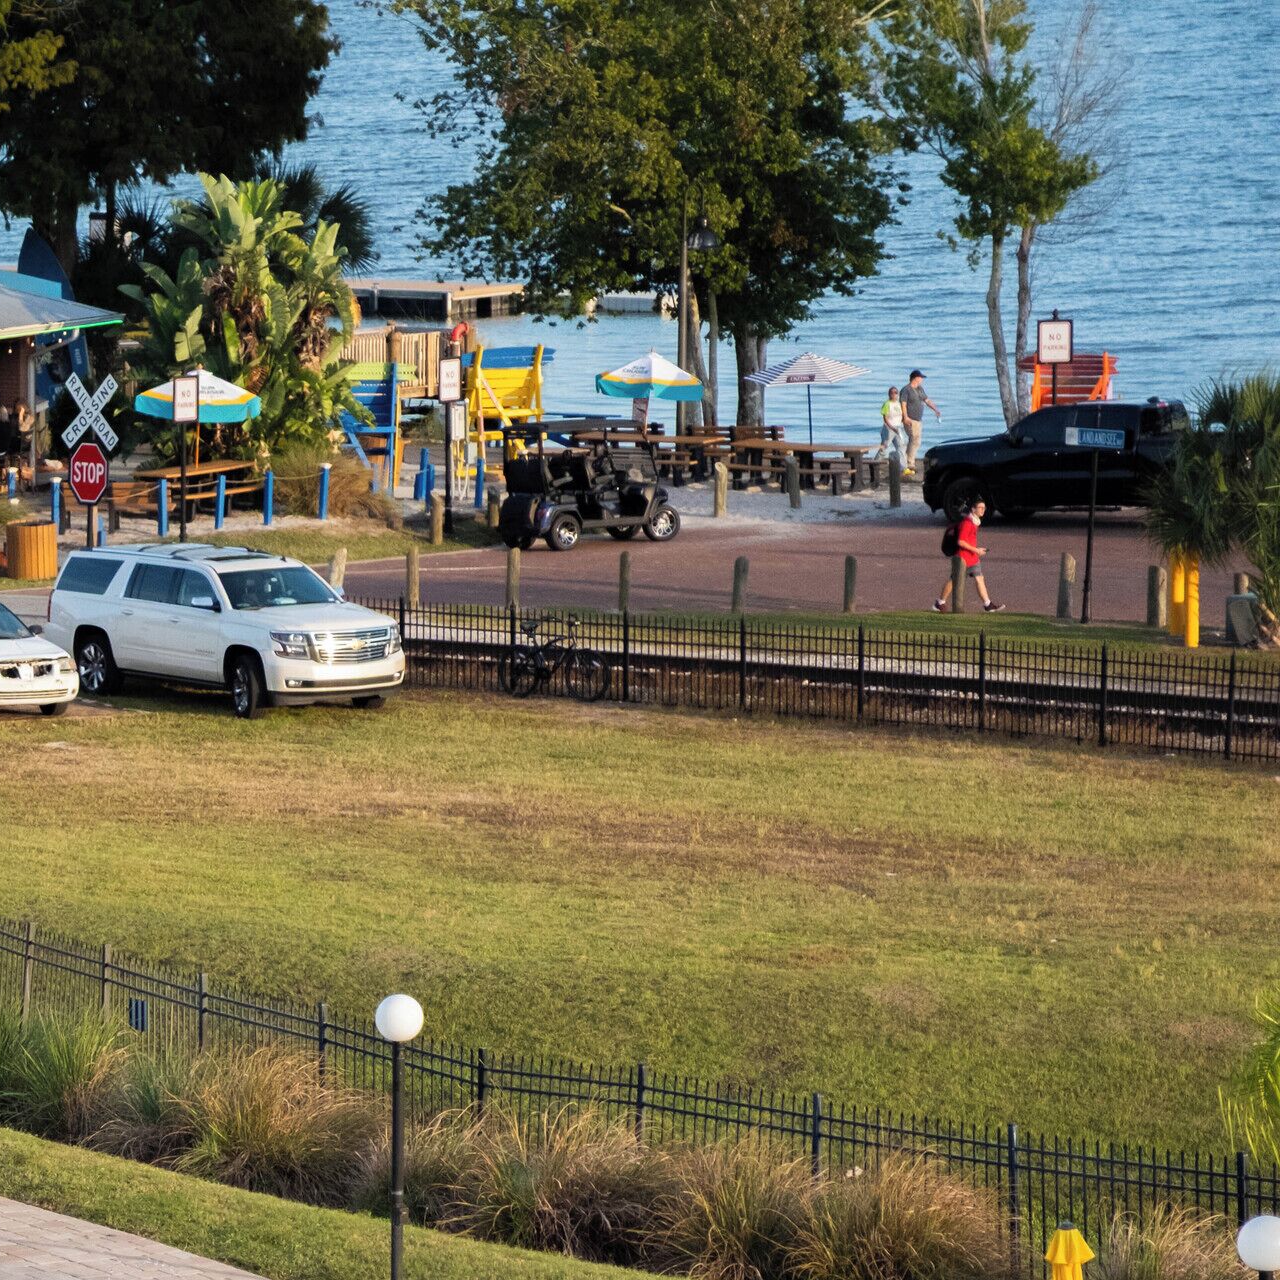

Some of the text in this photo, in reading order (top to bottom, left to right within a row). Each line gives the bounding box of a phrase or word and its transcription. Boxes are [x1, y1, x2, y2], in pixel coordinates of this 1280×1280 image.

[1049, 333, 1061, 341] NO
[181, 390, 191, 398] NO
[65, 379, 115, 443] CROSSING
[73, 461, 105, 483] STOP
